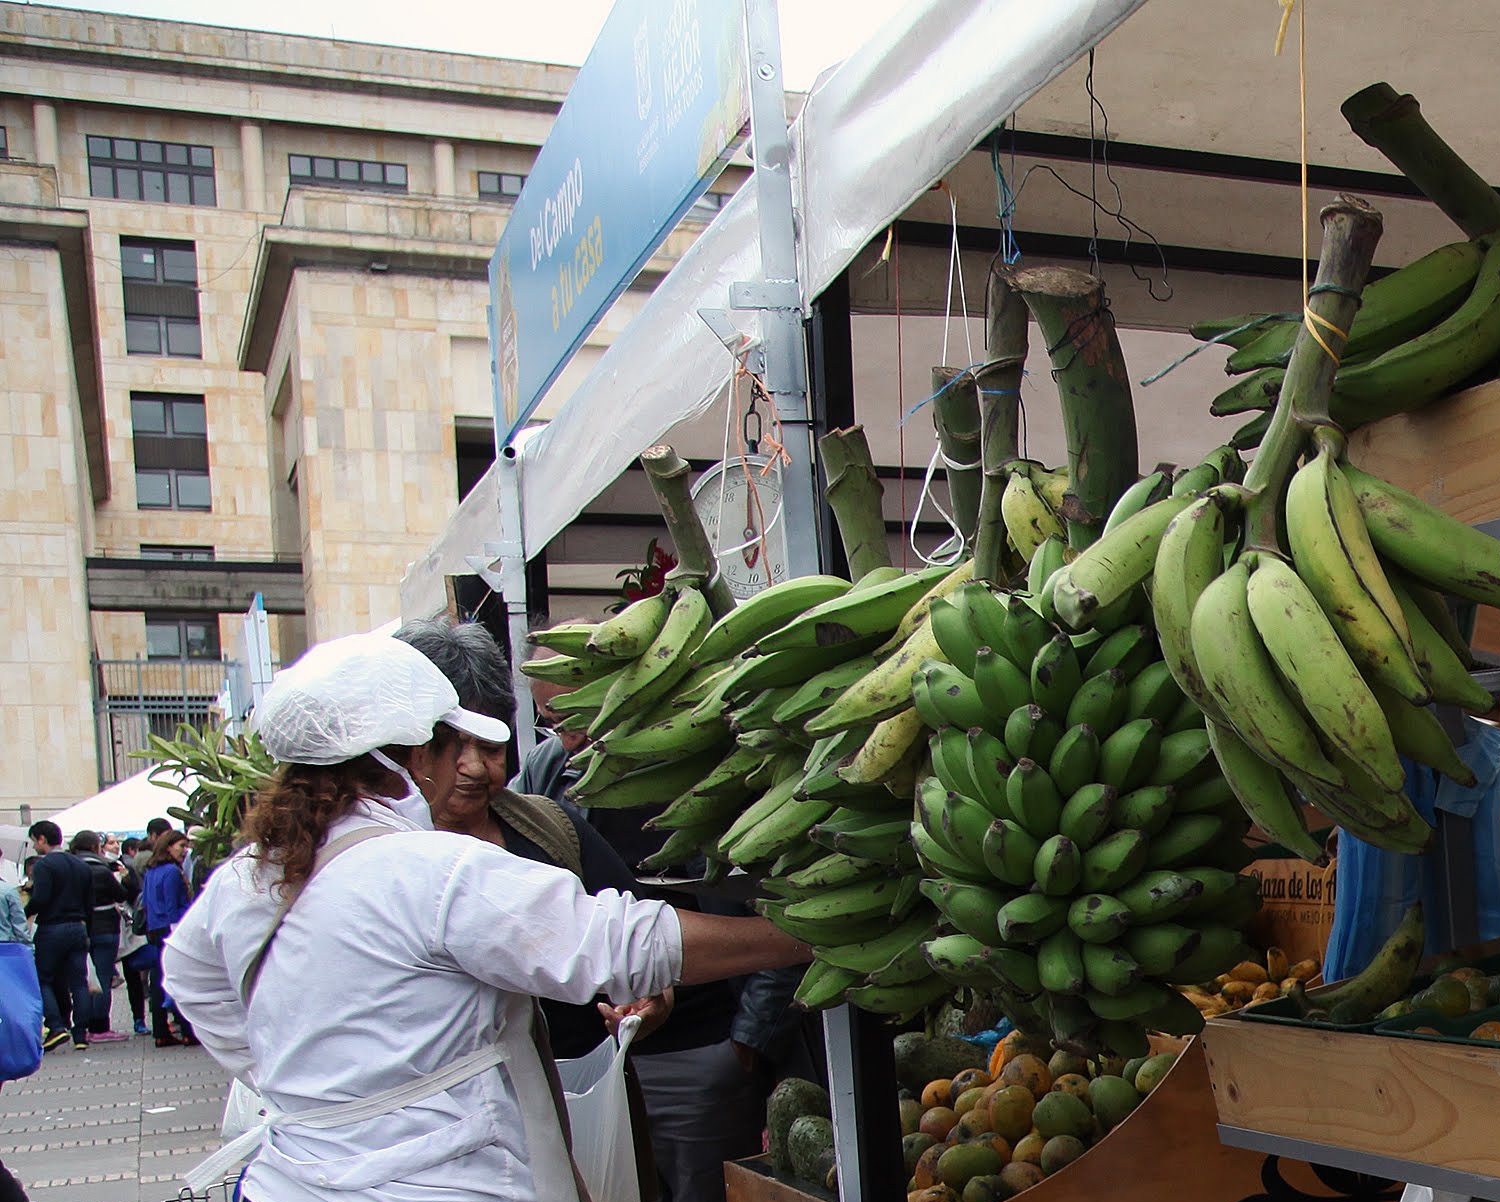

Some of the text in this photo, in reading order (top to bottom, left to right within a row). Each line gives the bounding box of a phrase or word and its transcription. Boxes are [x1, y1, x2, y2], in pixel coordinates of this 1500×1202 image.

[530, 157, 583, 272] Del Campo
[552, 214, 604, 334] a tu casa
[724, 491, 735, 504] 18
[771, 492, 779, 504] 2
[726, 564, 738, 577] 12
[748, 573, 760, 584] 10
[1288, 870, 1303, 900] de
